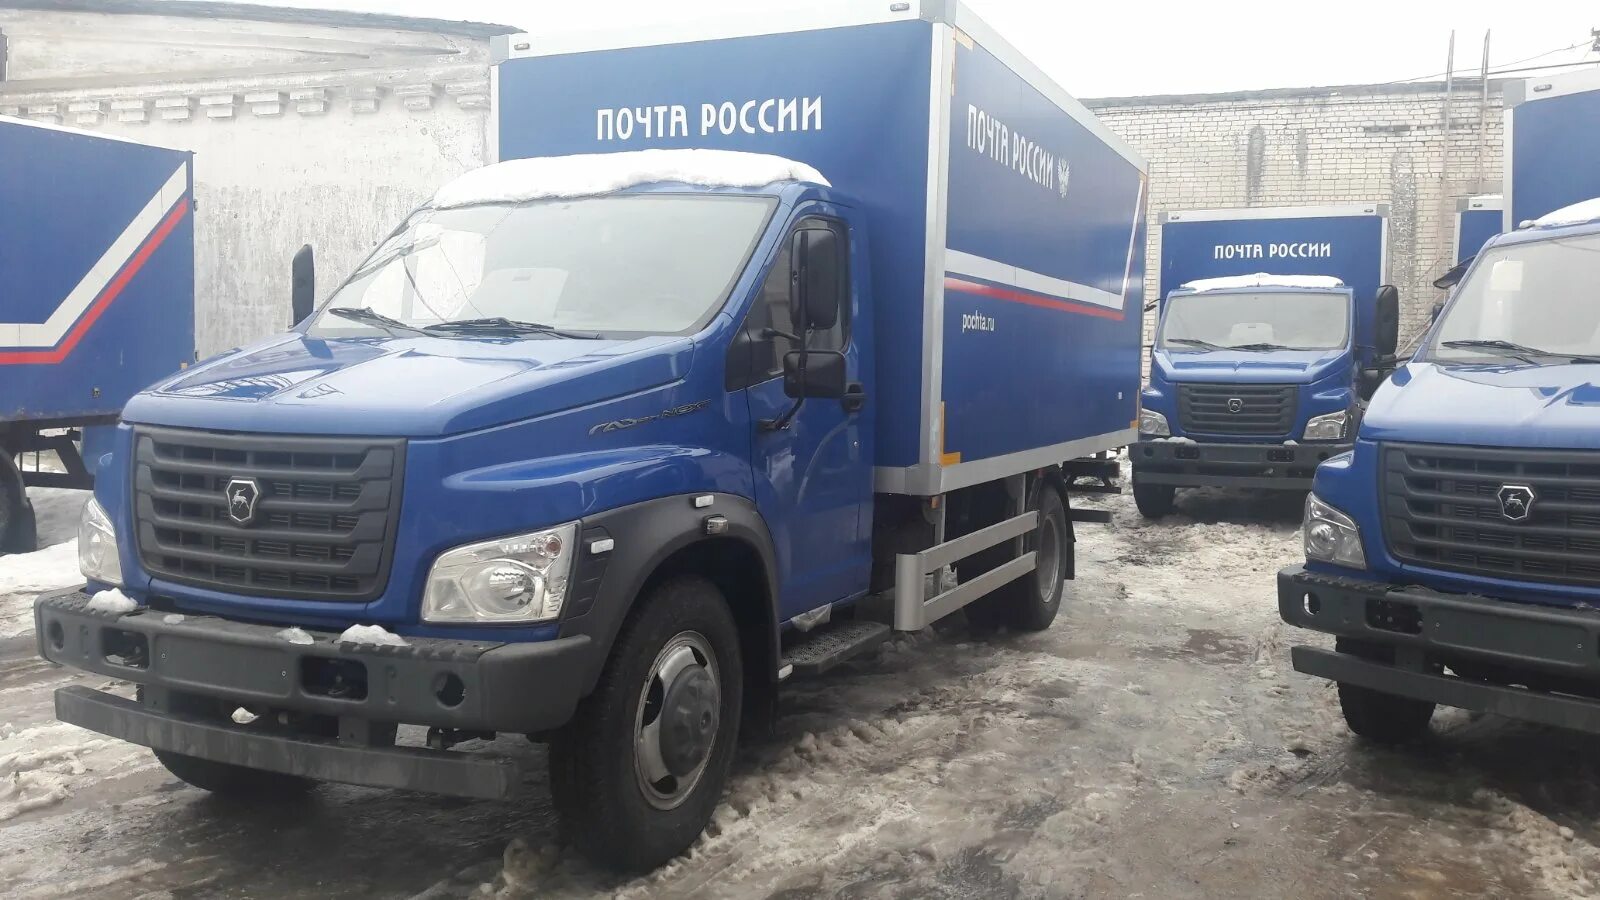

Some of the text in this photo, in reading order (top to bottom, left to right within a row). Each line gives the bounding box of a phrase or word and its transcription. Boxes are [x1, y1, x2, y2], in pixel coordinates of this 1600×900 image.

[597, 95, 822, 140] ПОЧТА РОССИИ
[967, 103, 1054, 190] ПОЧТА РОССИИ
[1214, 242, 1331, 259] ПОЧТА РОССИИ
[962, 309, 995, 333] pochta.ru
